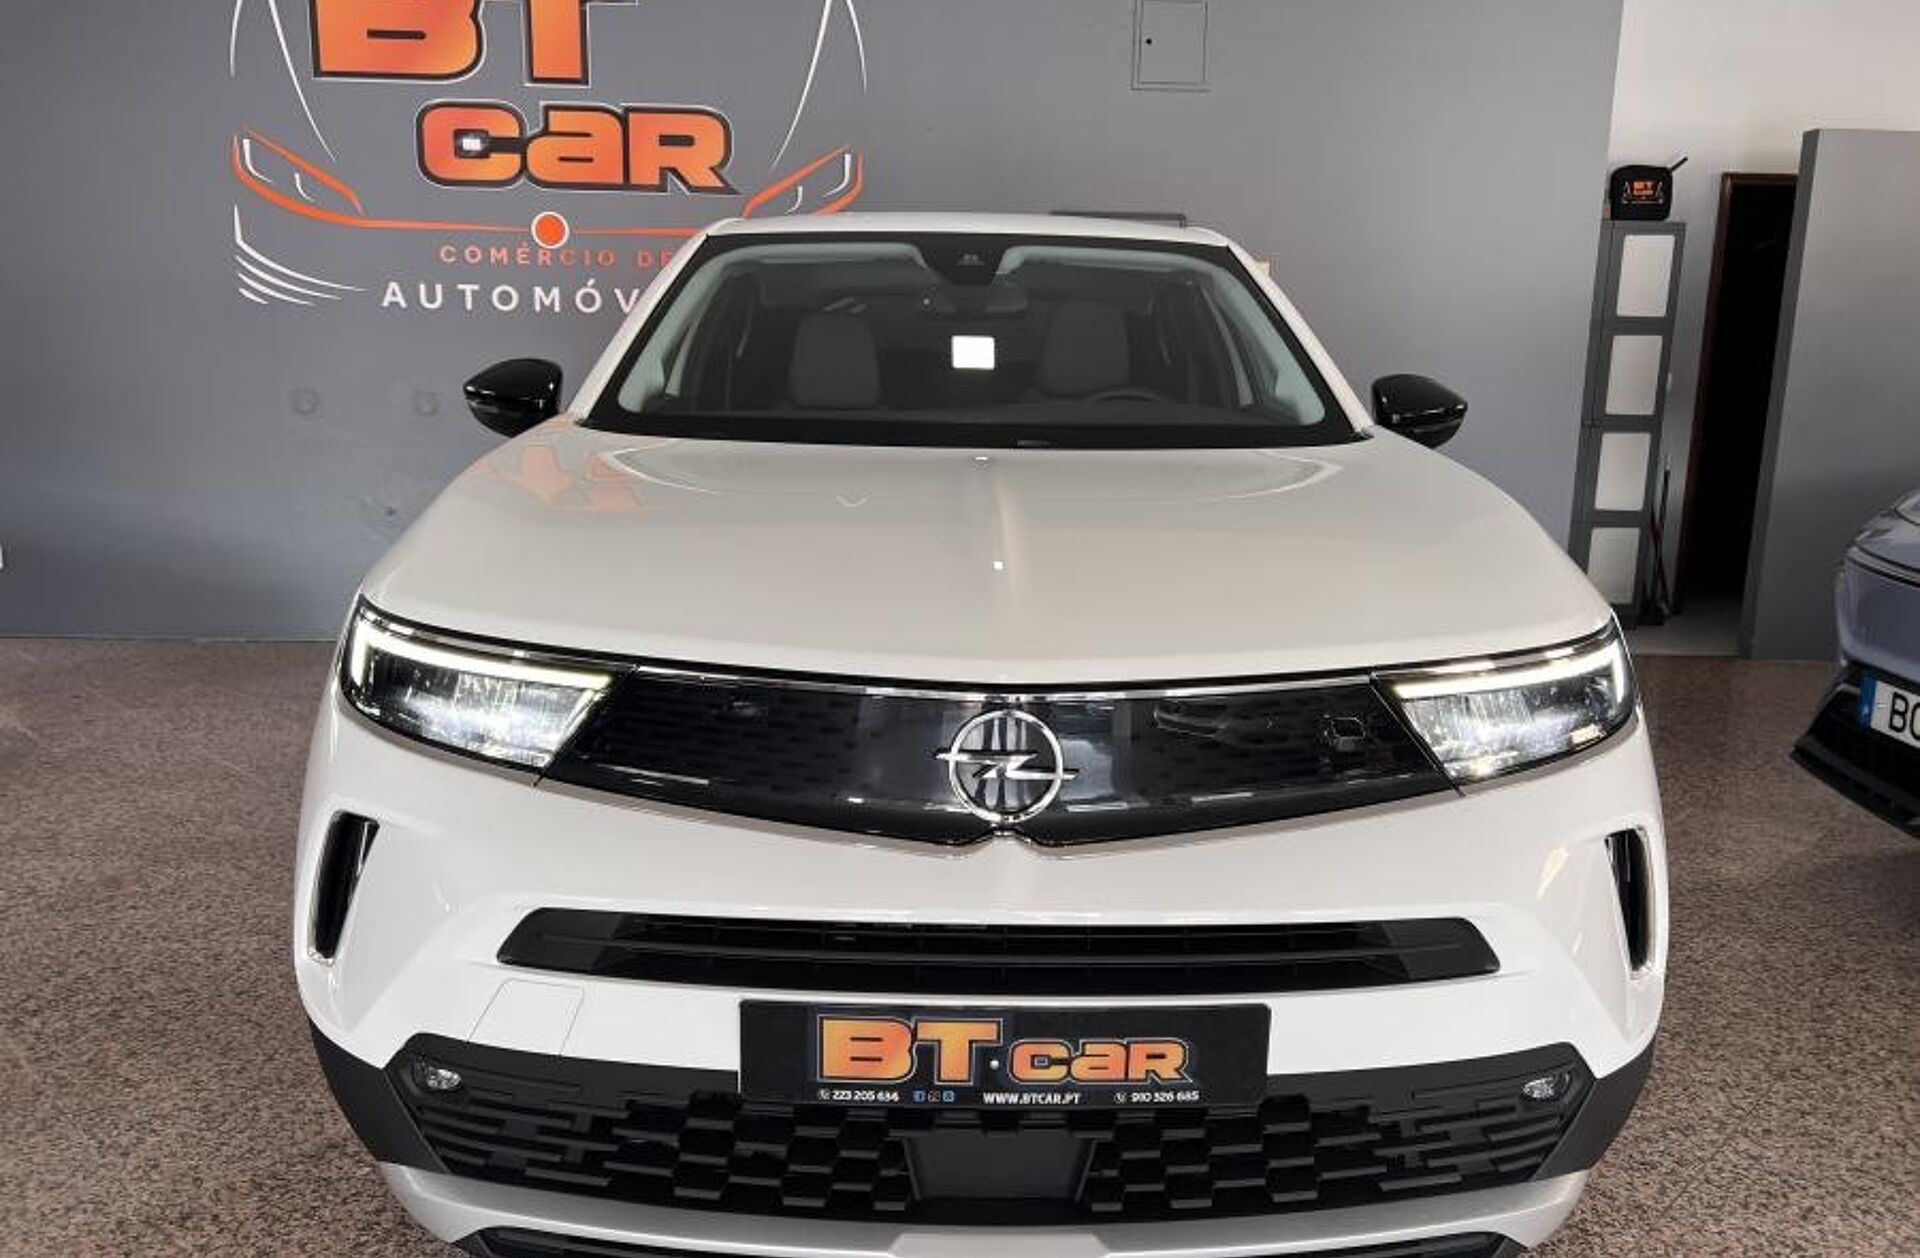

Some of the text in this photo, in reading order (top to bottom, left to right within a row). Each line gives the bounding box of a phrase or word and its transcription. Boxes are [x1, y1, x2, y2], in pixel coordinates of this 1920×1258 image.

[440, 242, 616, 267] COMÉRCIO
[817, 1015, 1003, 1085] BT
[983, 1092, 1081, 1105] WWW.BTCAR.PT
